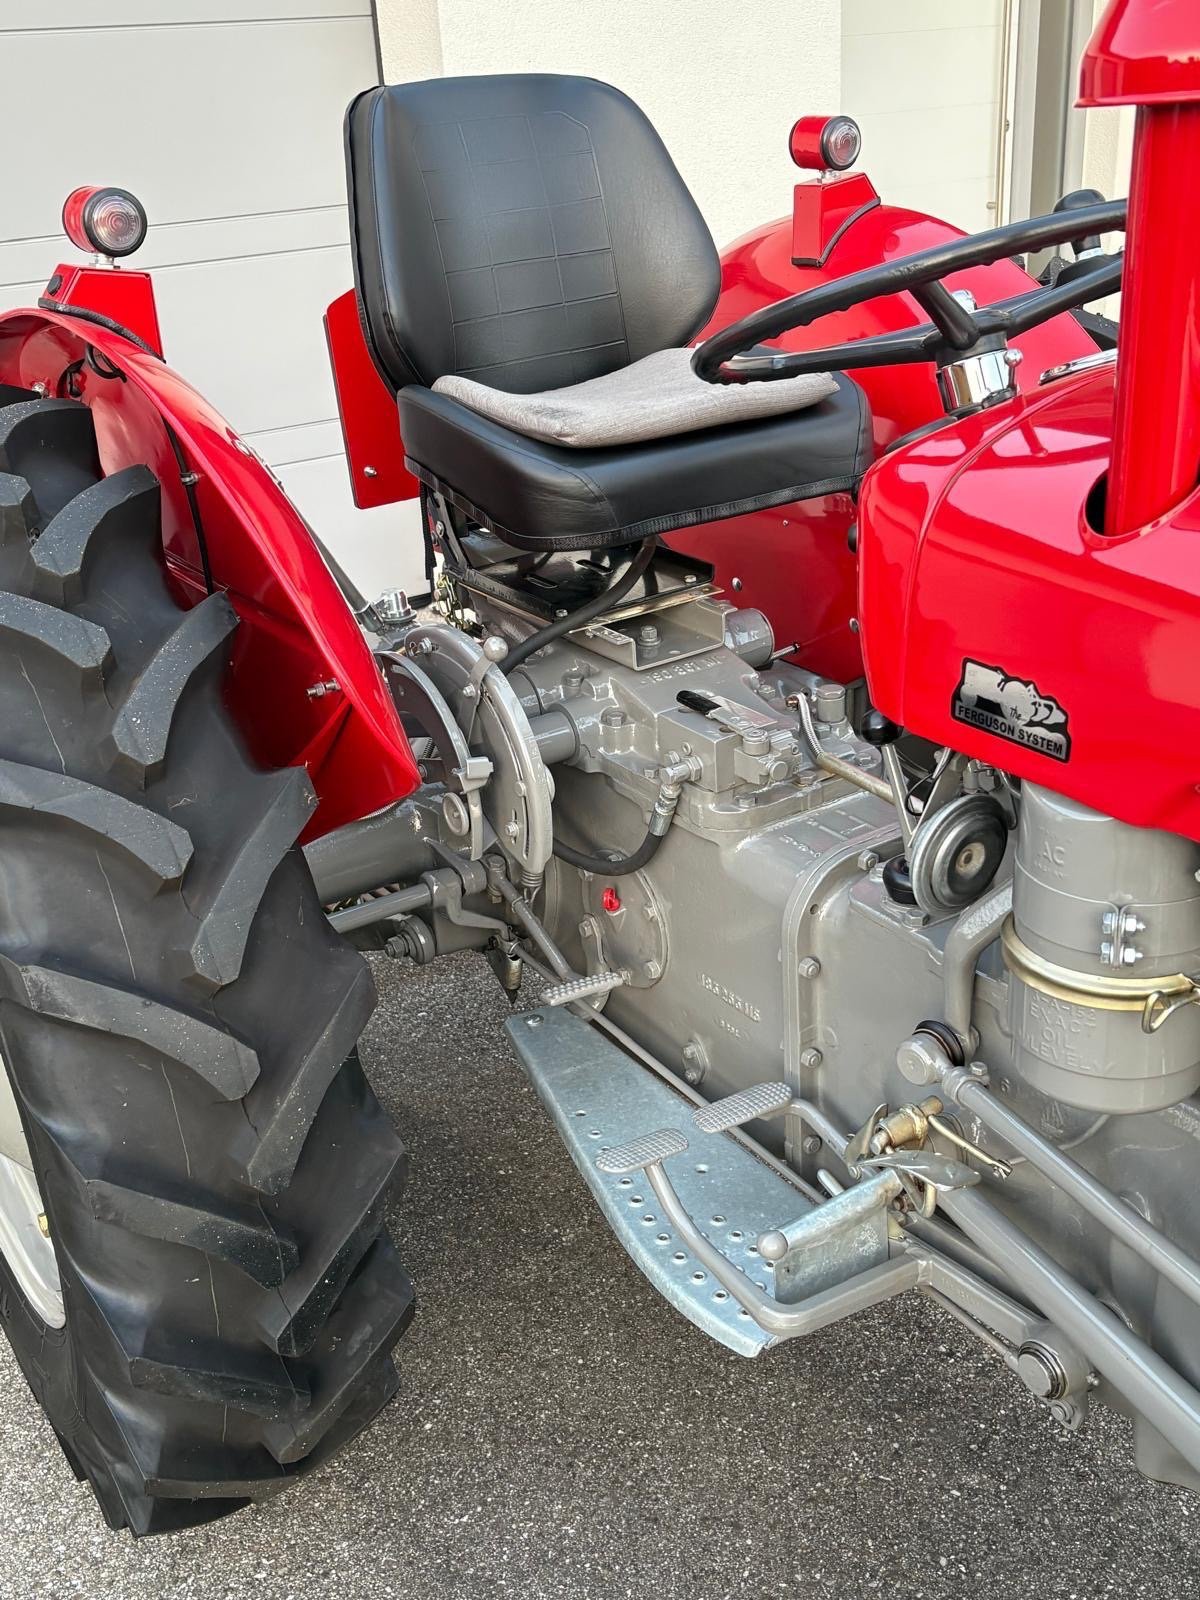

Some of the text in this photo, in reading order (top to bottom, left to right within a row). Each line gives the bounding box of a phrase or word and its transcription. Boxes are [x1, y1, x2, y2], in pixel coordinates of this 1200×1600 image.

[958, 706, 1063, 755] FERGUSON SYSTEM
[1041, 841, 1065, 866] AC
[1031, 1001, 1097, 1032] EXACT
[1030, 1033, 1092, 1070] LEVEL
[1043, 1026, 1077, 1050] OIL
